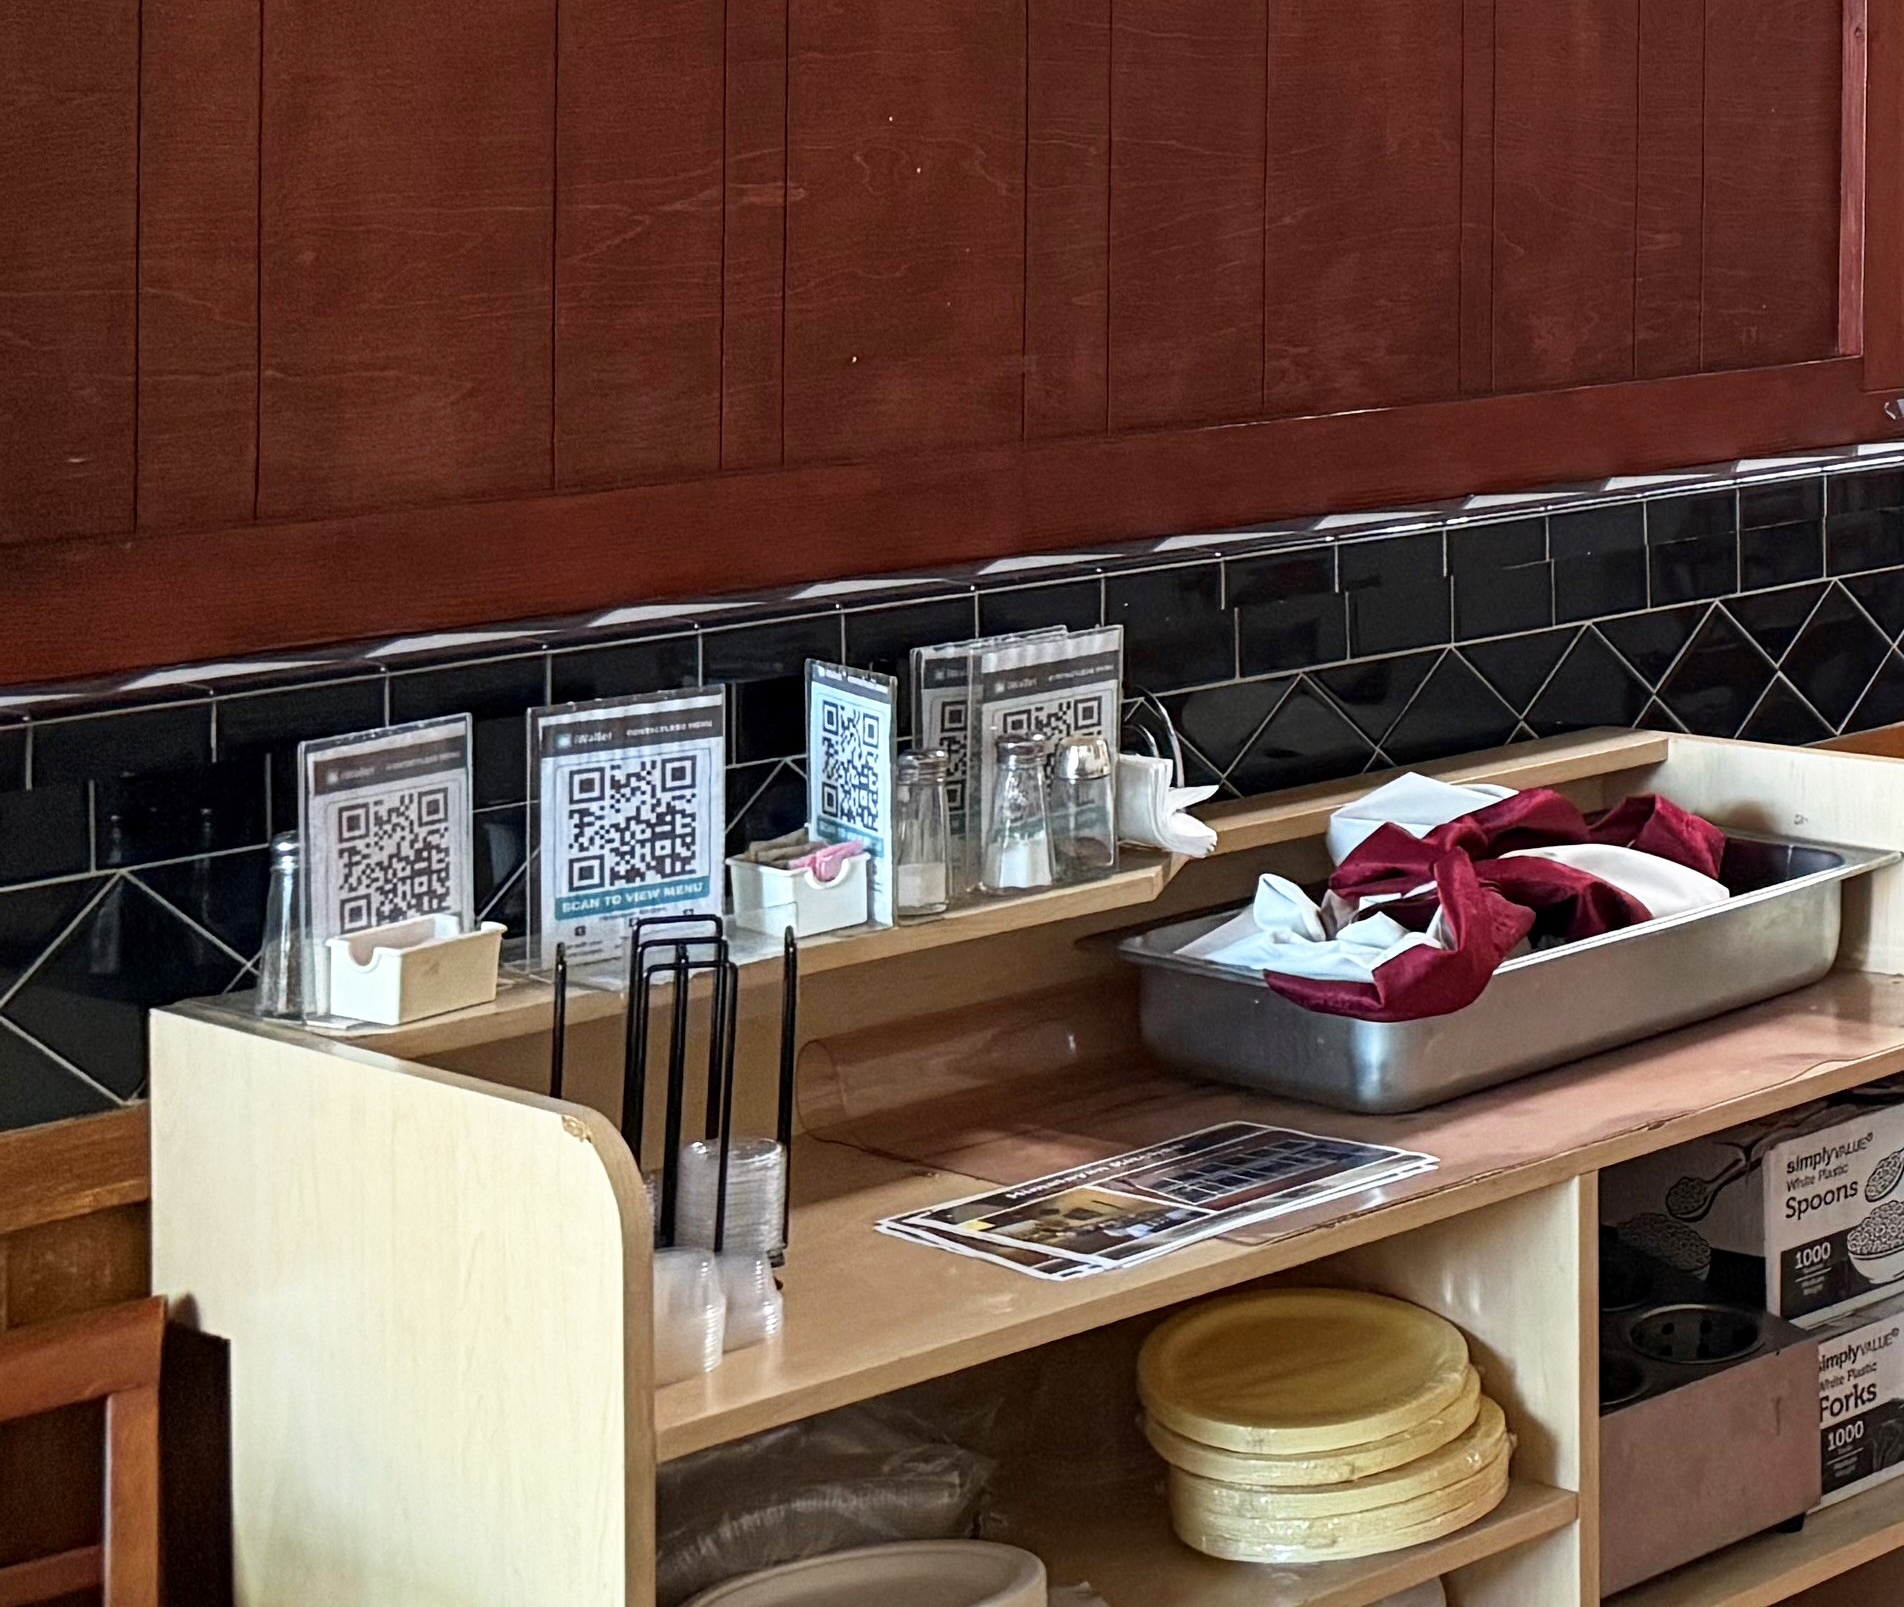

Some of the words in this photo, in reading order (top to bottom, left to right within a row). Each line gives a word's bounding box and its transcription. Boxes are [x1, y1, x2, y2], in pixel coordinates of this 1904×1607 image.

[562, 898, 600, 914] SCAN
[604, 895, 622, 907] TO
[625, 887, 660, 903] VIEW
[664, 882, 704, 898] MENU
[1786, 1175, 1816, 1192] White
[1818, 1163, 1849, 1181] Plastic
[1785, 1181, 1859, 1220] Spoons
[1795, 1242, 1832, 1269] 1000
[1847, 1361, 1877, 1382] Plastic
[1820, 1383, 1877, 1423] Forks
[1827, 1420, 1864, 1451] 1000
